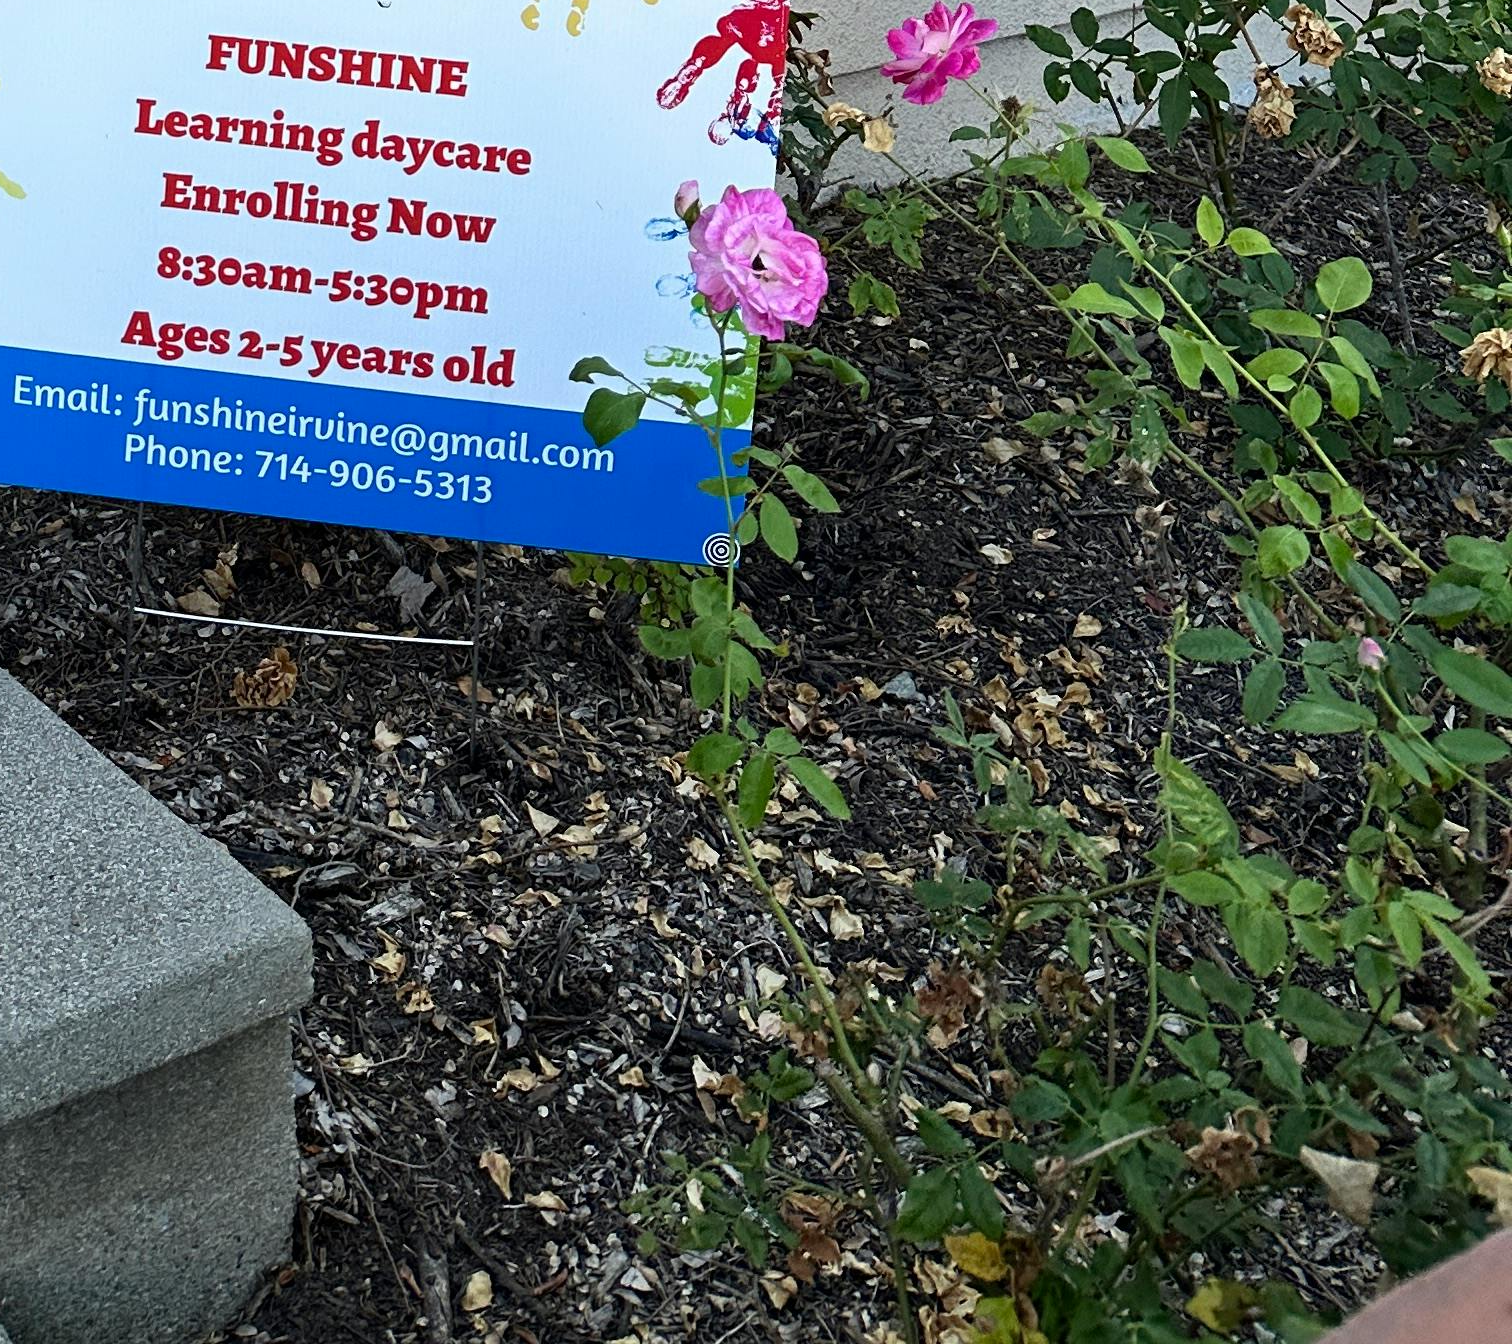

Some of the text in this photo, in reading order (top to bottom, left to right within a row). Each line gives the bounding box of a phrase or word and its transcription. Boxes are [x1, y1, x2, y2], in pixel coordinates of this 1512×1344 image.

[205, 34, 470, 97] FUNSHINE
[134, 98, 532, 176] Learning daycare
[160, 172, 497, 244] Enrolling Now
[156, 246, 489, 320] 8:30am-5:30pm
[120, 310, 517, 388] Ages 2-5 years old
[13, 374, 615, 472] Email: funshineirvine@gmail.com
[124, 433, 493, 504] Phone: 714-906-5313
